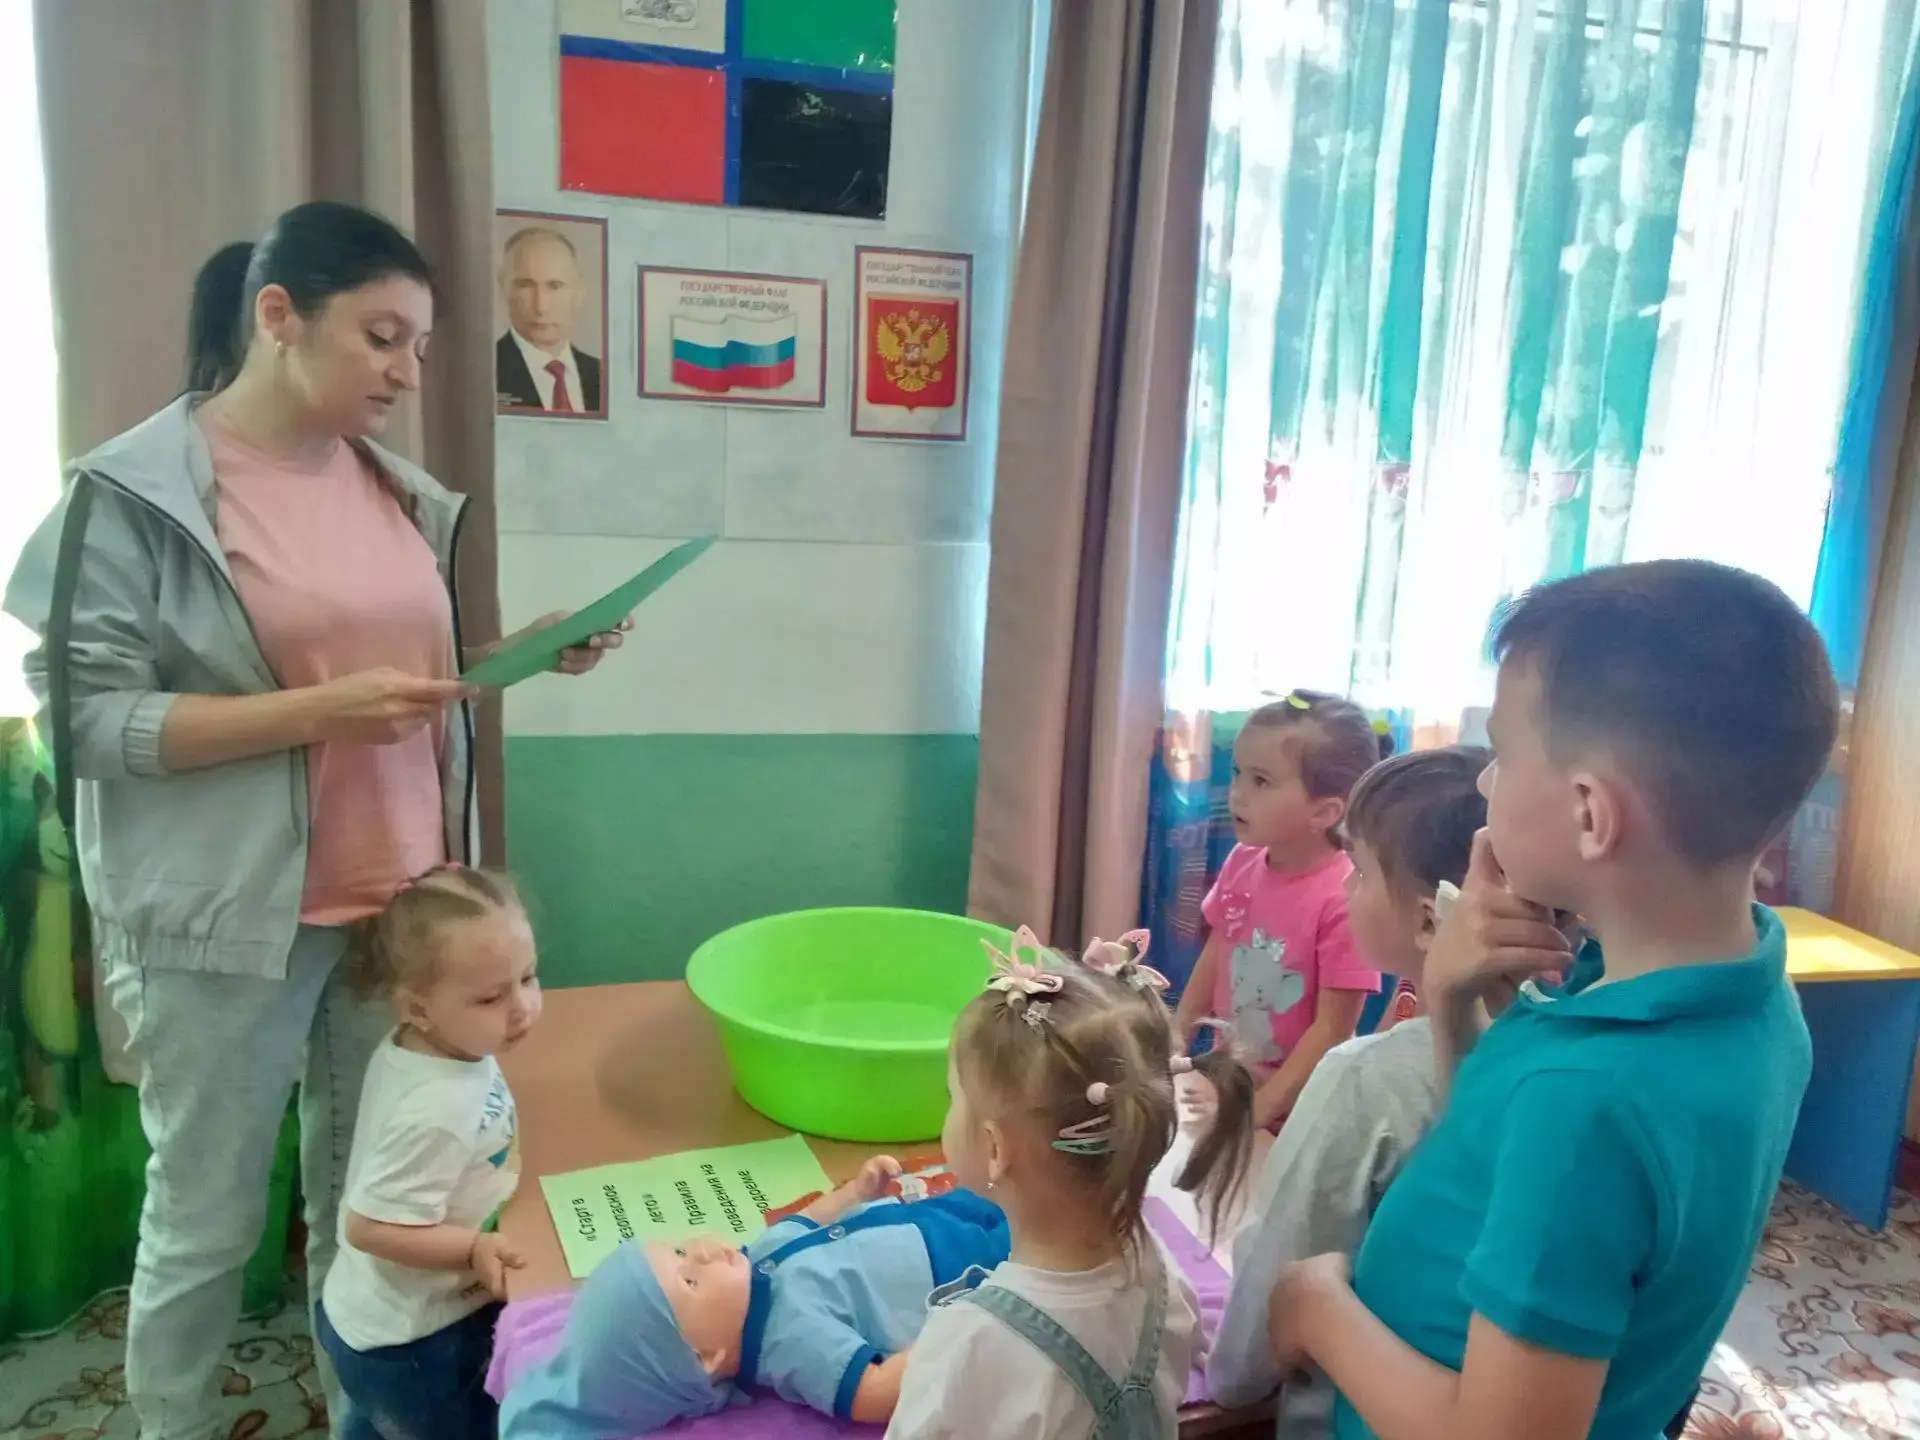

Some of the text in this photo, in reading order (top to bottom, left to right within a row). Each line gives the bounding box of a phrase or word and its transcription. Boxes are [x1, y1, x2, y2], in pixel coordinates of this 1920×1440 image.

[571, 1197, 598, 1242] «Старт в
[642, 1193, 667, 1224] лето»
[673, 1180, 708, 1226] Правила
[699, 1163, 748, 1234] поведения на
